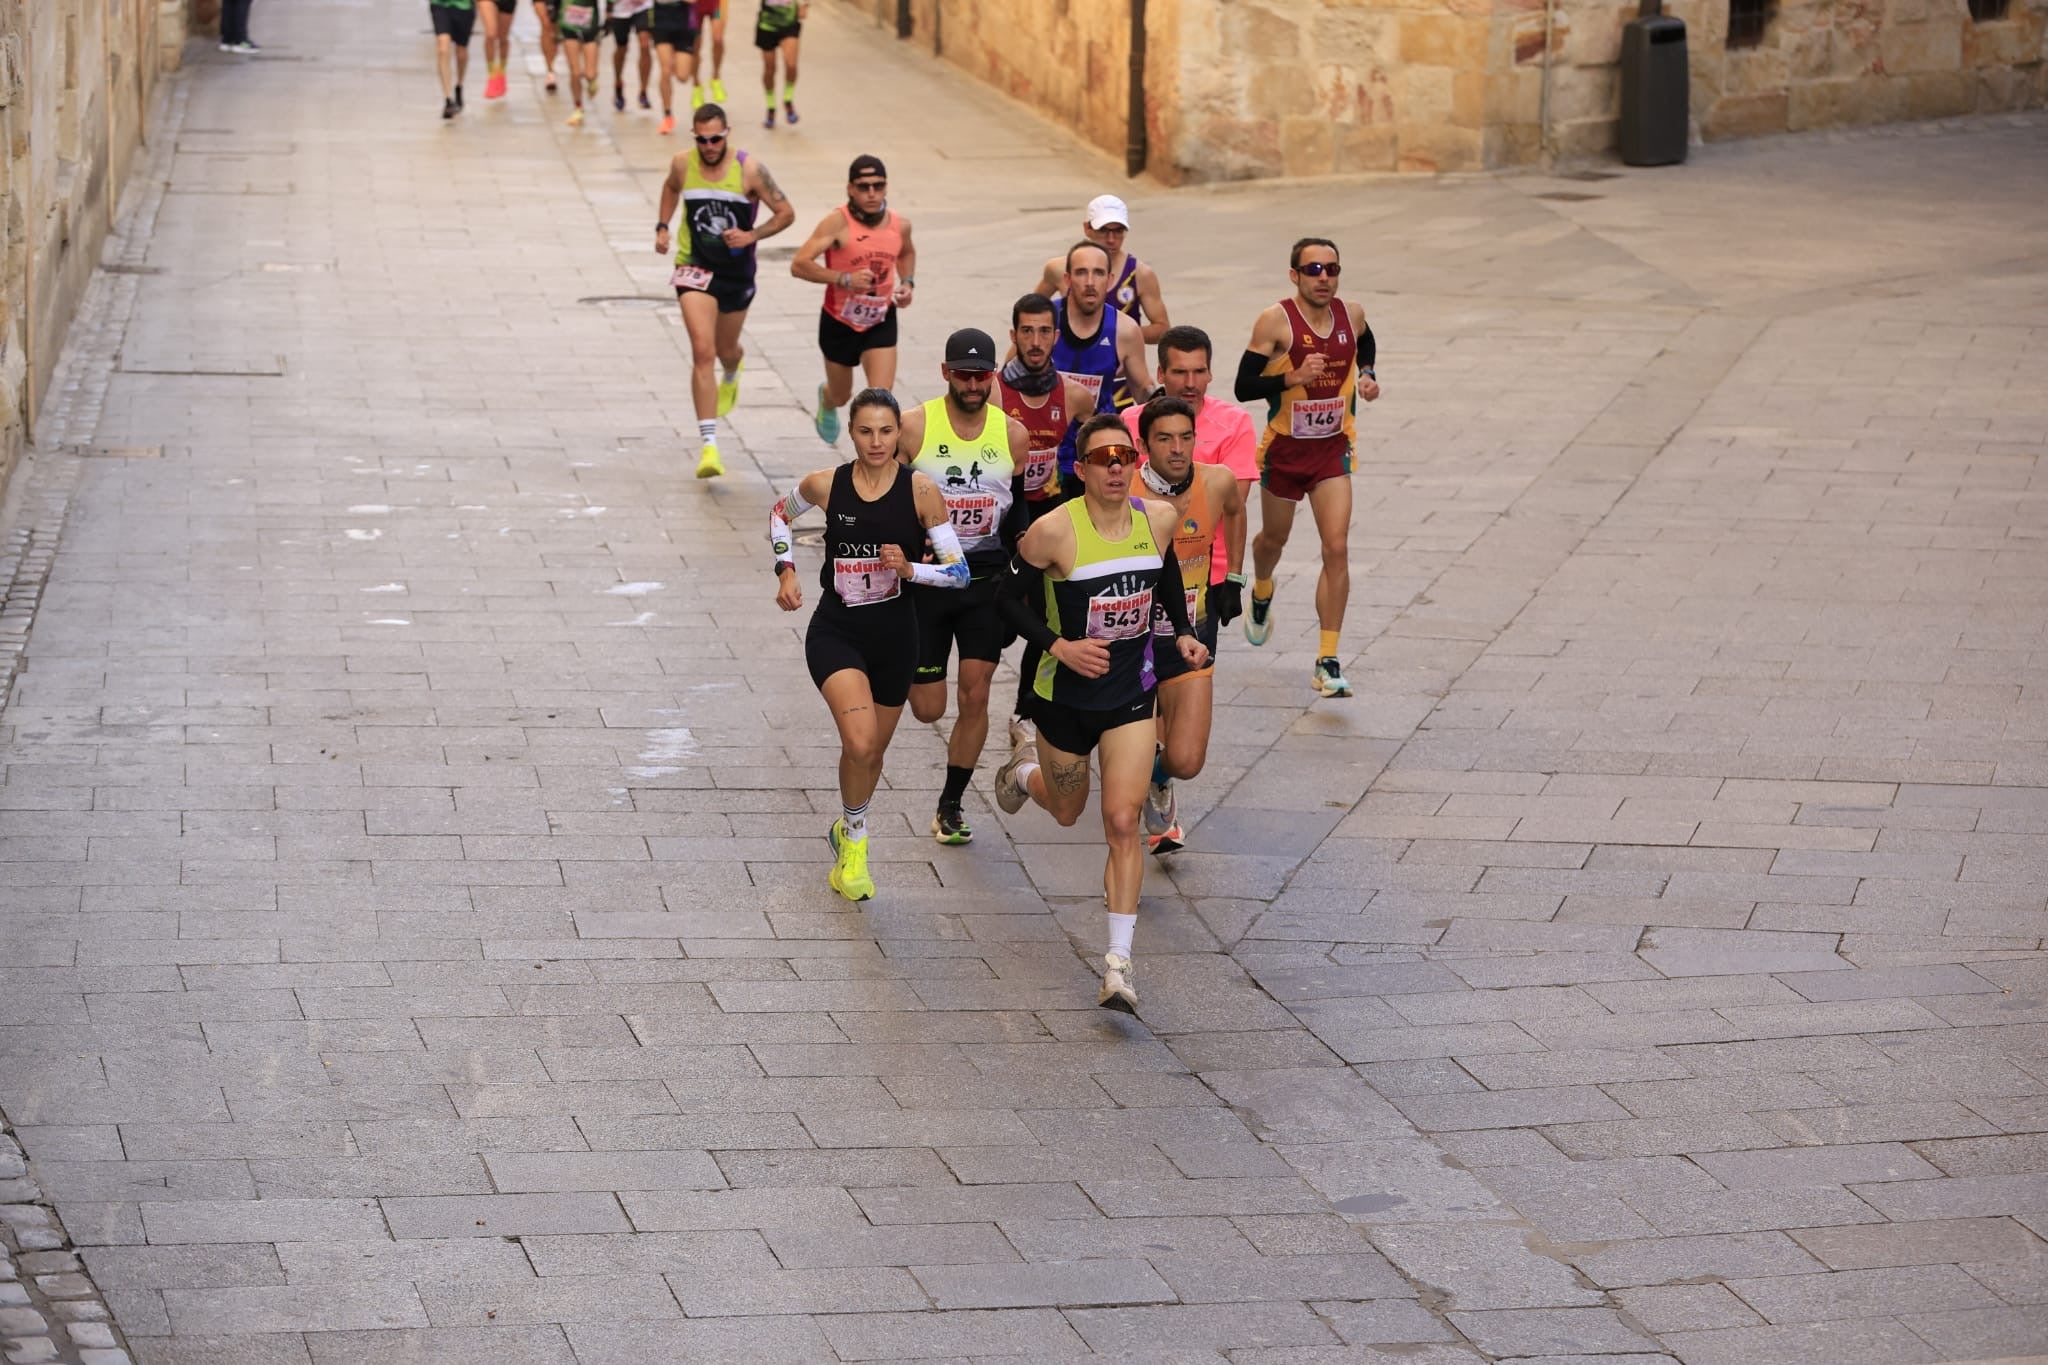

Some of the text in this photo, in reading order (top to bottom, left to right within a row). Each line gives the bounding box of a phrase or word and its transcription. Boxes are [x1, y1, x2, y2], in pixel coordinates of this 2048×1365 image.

[854, 305, 878, 318] 612
[1293, 400, 1344, 412] bedunia
[1305, 411, 1335, 426] 146
[1026, 463, 1046, 478] 65
[944, 496, 995, 509] edunia
[949, 509, 983, 525] 125
[862, 573, 871, 589] 1
[1091, 593, 1151, 611] bedunia
[1103, 608, 1140, 628] 543
